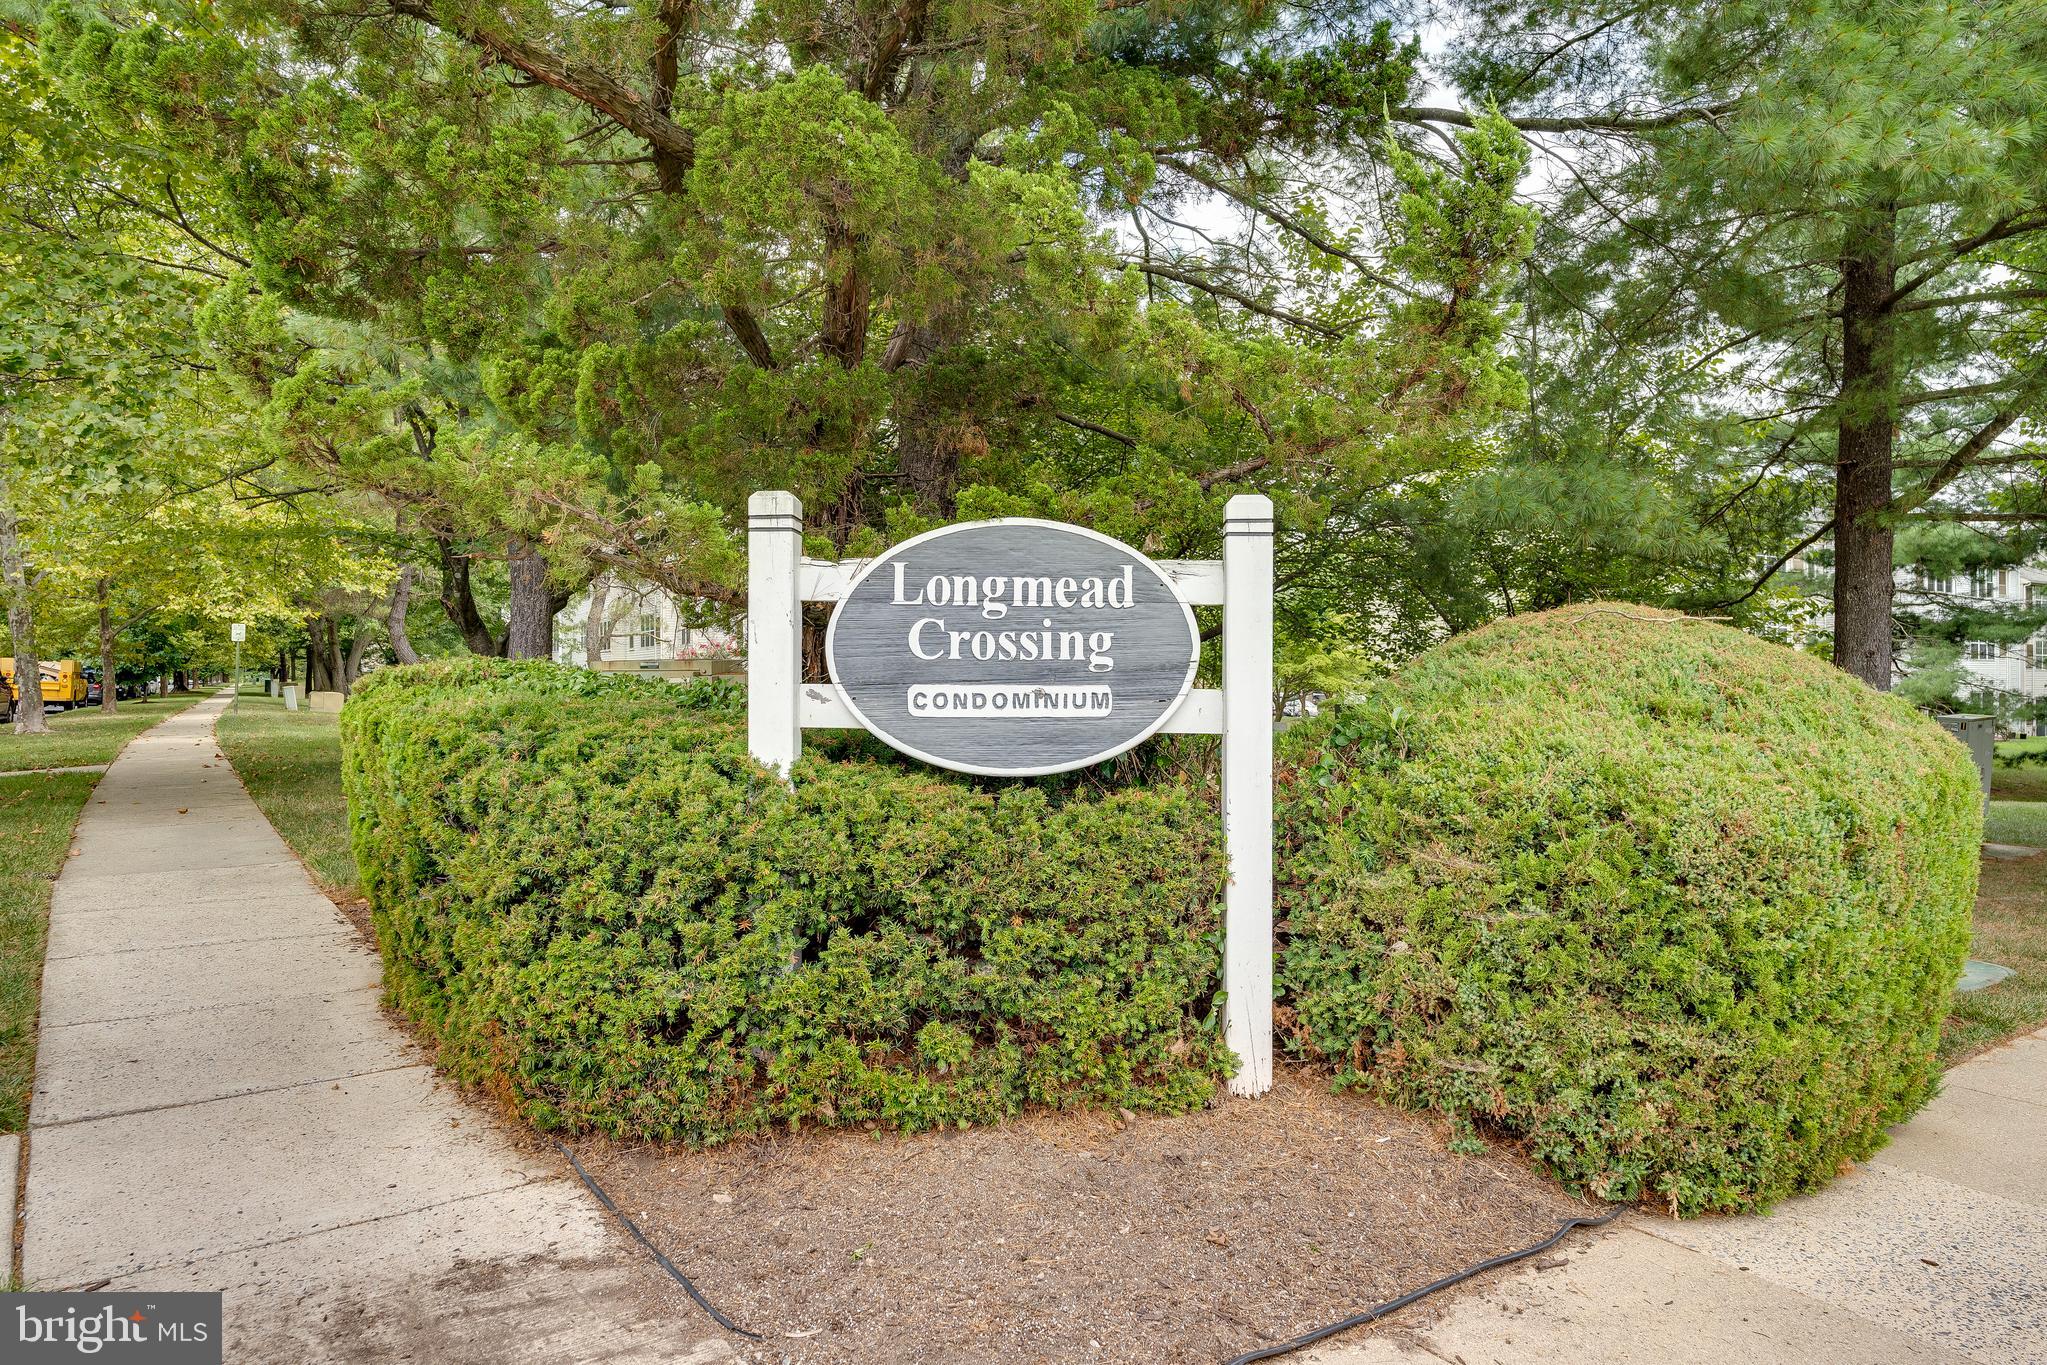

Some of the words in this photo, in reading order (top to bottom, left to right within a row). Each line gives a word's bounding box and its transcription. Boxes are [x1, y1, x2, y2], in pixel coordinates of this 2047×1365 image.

[890, 562, 1135, 620] Longmead
[908, 617, 1115, 673] Crossing
[912, 691, 1110, 711] CONDOMINIUM
